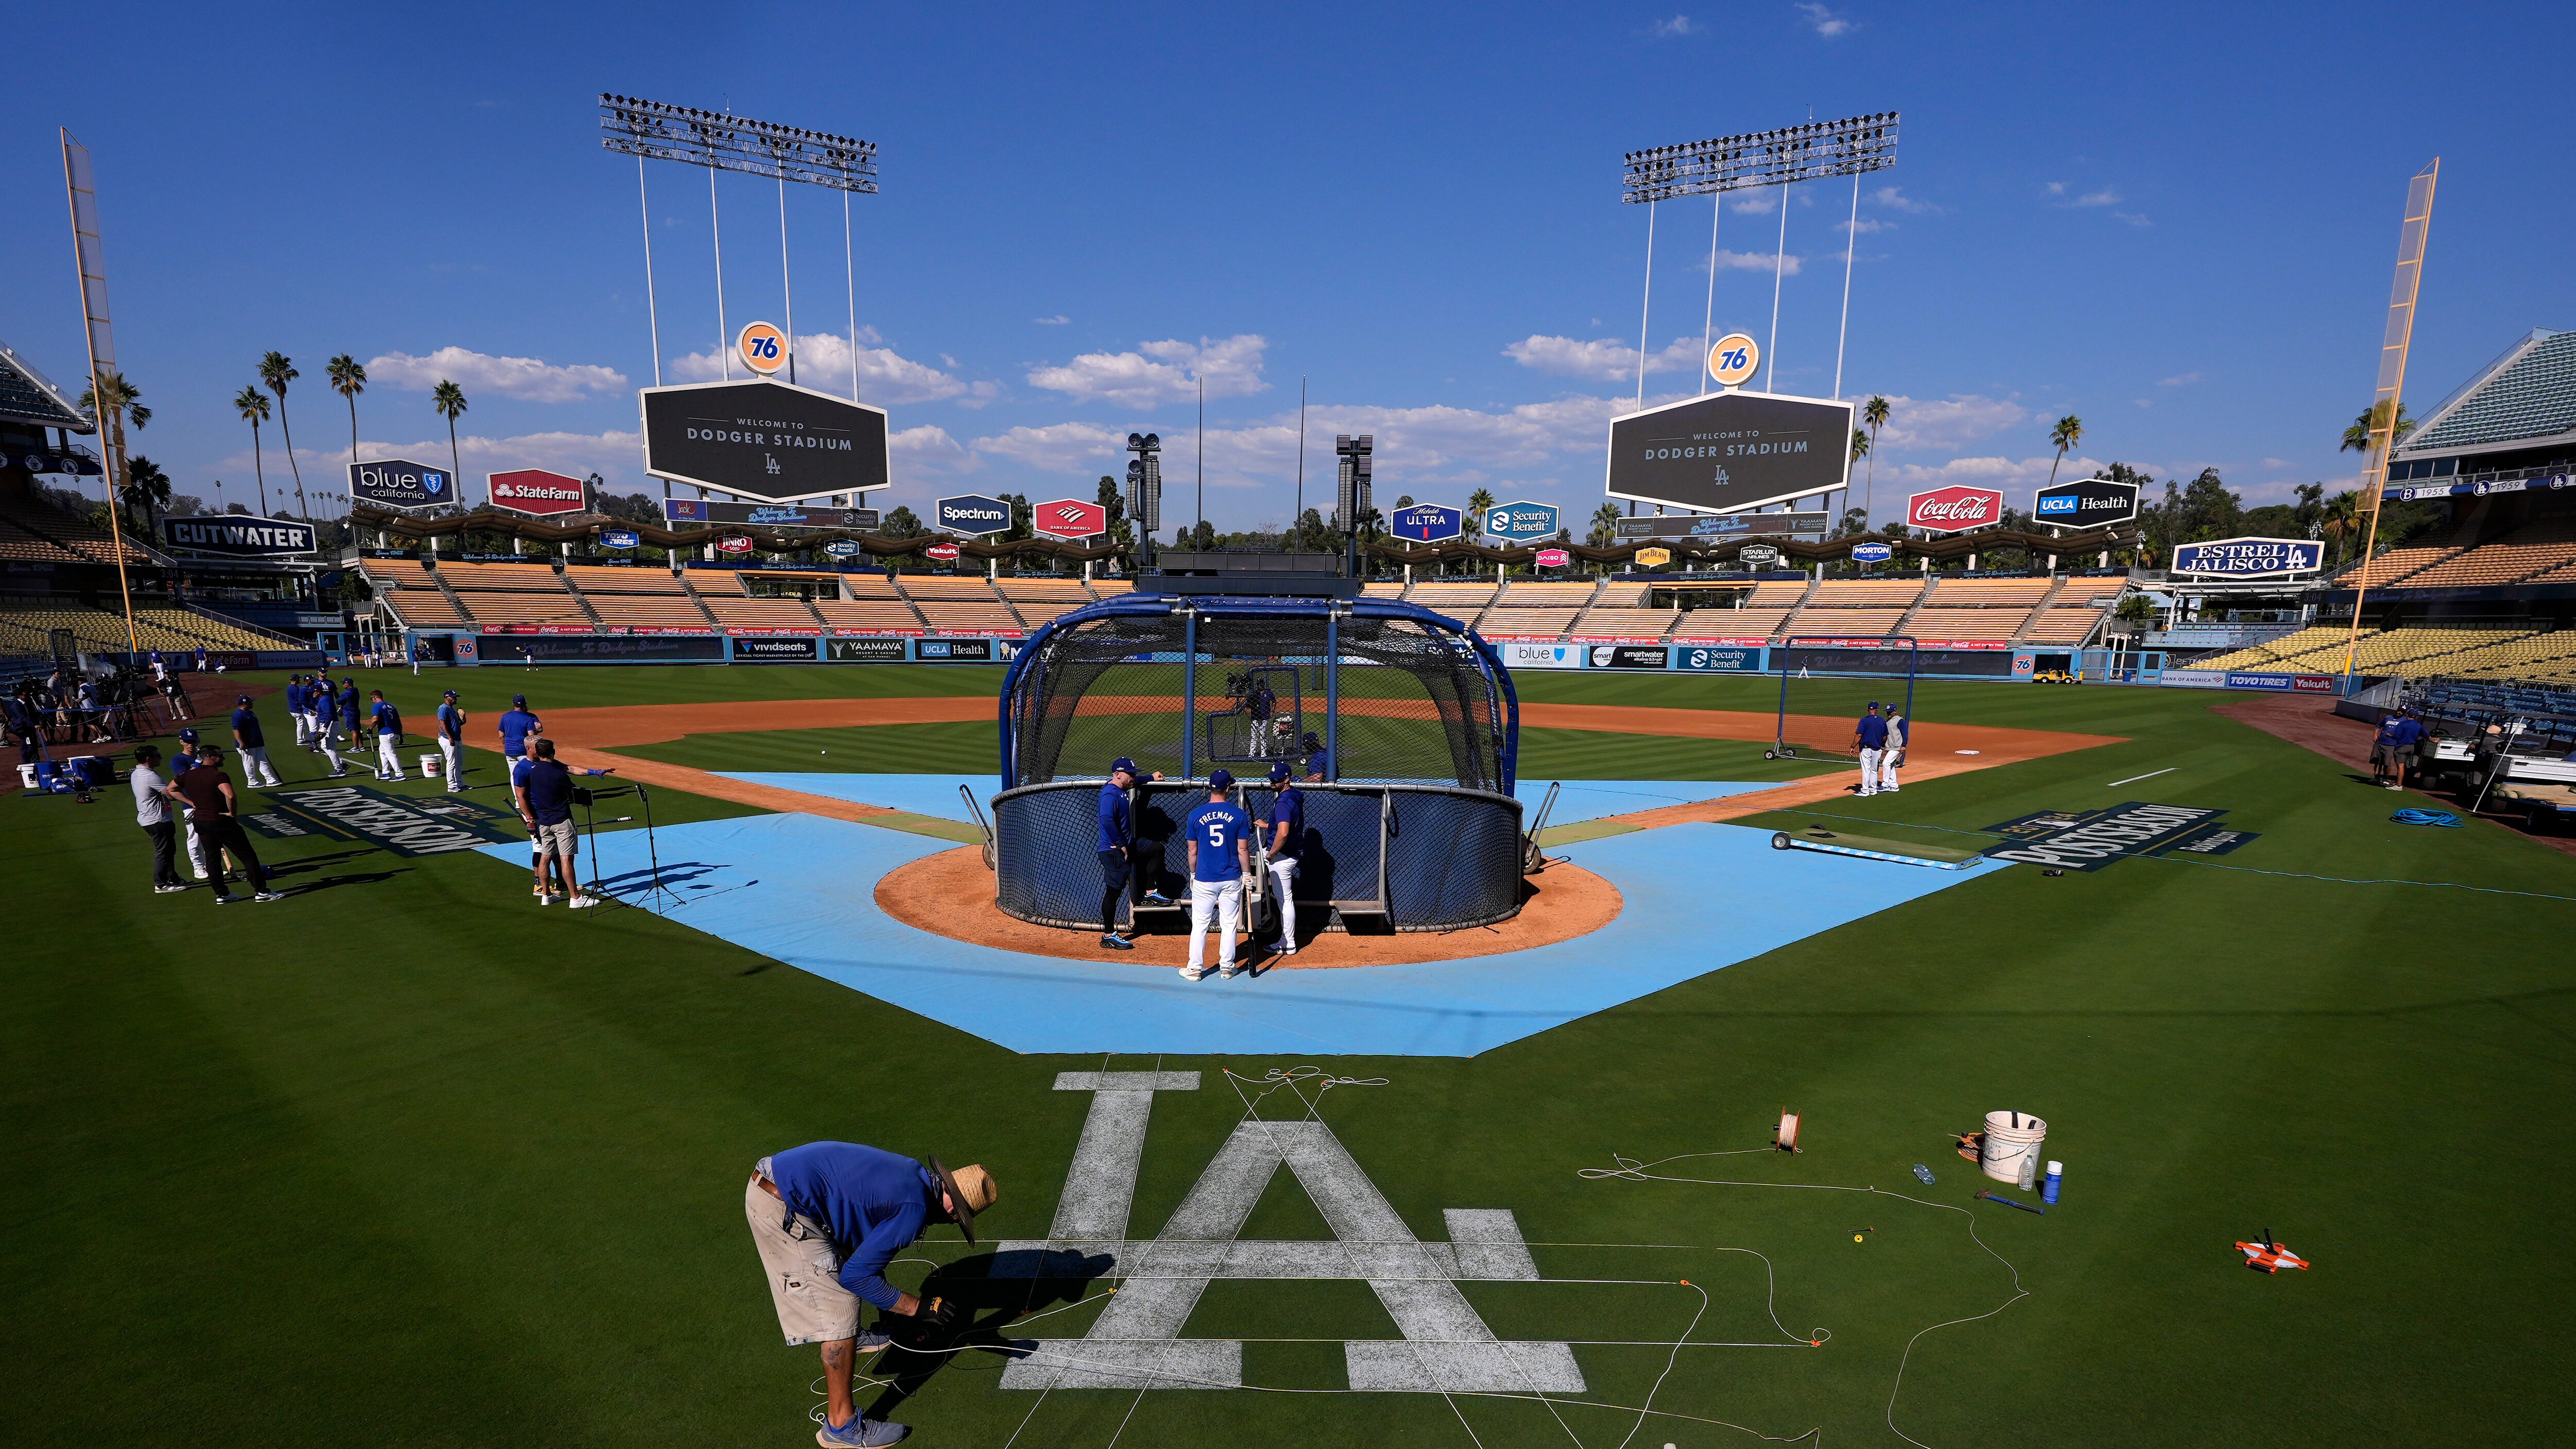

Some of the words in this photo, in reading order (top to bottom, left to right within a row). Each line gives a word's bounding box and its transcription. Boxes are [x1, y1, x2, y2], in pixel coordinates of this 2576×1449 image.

[750, 336, 779, 360] 76
[1718, 347, 1748, 370] 76
[736, 418, 787, 428] WELCOME
[687, 428, 765, 444] DODGER
[774, 434, 852, 451] STADIUM
[1693, 431, 1741, 441] WELCOME
[1645, 446, 1717, 460] DODGER
[1726, 441, 1807, 456] STADIUM
[765, 453, 780, 475] LA
[360, 466, 416, 489] blue
[1715, 465, 1729, 485] LA
[2476, 481, 2487, 493] LA
[2497, 482, 2520, 491] 1959
[2553, 476, 2563, 487] LA
[371, 489, 425, 499] california
[2403, 488, 2413, 499] B
[2421, 488, 2444, 496] 1955
[677, 503, 696, 514] Jack
[1916, 495, 1993, 521] Coca-Cola
[2042, 498, 2074, 511] UCLA
[2081, 496, 2128, 510] Health
[756, 507, 784, 515] Welcome
[944, 506, 1001, 521] Spectrum
[1513, 511, 1552, 523] Security
[748, 513, 776, 523] Dodger
[1406, 516, 1446, 525] ULTRA
[1700, 517, 1730, 526] Welcome
[1513, 521, 1546, 532] Benefit
[1691, 525, 1718, 535] Dodger
[1718, 523, 1750, 531] Stadium
[175, 524, 305, 547] CUTWATER
[722, 537, 747, 548] JINRO
[1638, 552, 1649, 562] JIM
[1650, 549, 1667, 561] BEAM
[2196, 544, 2285, 559] ESTREL
[2185, 558, 2279, 571] JALISCO
[160, 568, 179, 578] 3:04
[2304, 593, 2321, 602] 3:04
[457, 642, 474, 654] 76
[925, 645, 947, 653] UCLA
[953, 645, 985, 654] Health
[1519, 647, 1550, 660] blue
[208, 655, 250, 666] SteFarm
[1710, 651, 1746, 662] Security
[1710, 660, 1740, 668] Benefit
[2015, 659, 2031, 670] 76
[2296, 679, 2330, 689] Yakult
[277, 787, 497, 854] POSTSEASON
[1198, 811, 1234, 825] FREEMAN
[1209, 823, 1224, 847] 5
[1990, 804, 2214, 868] POSTSEASON
